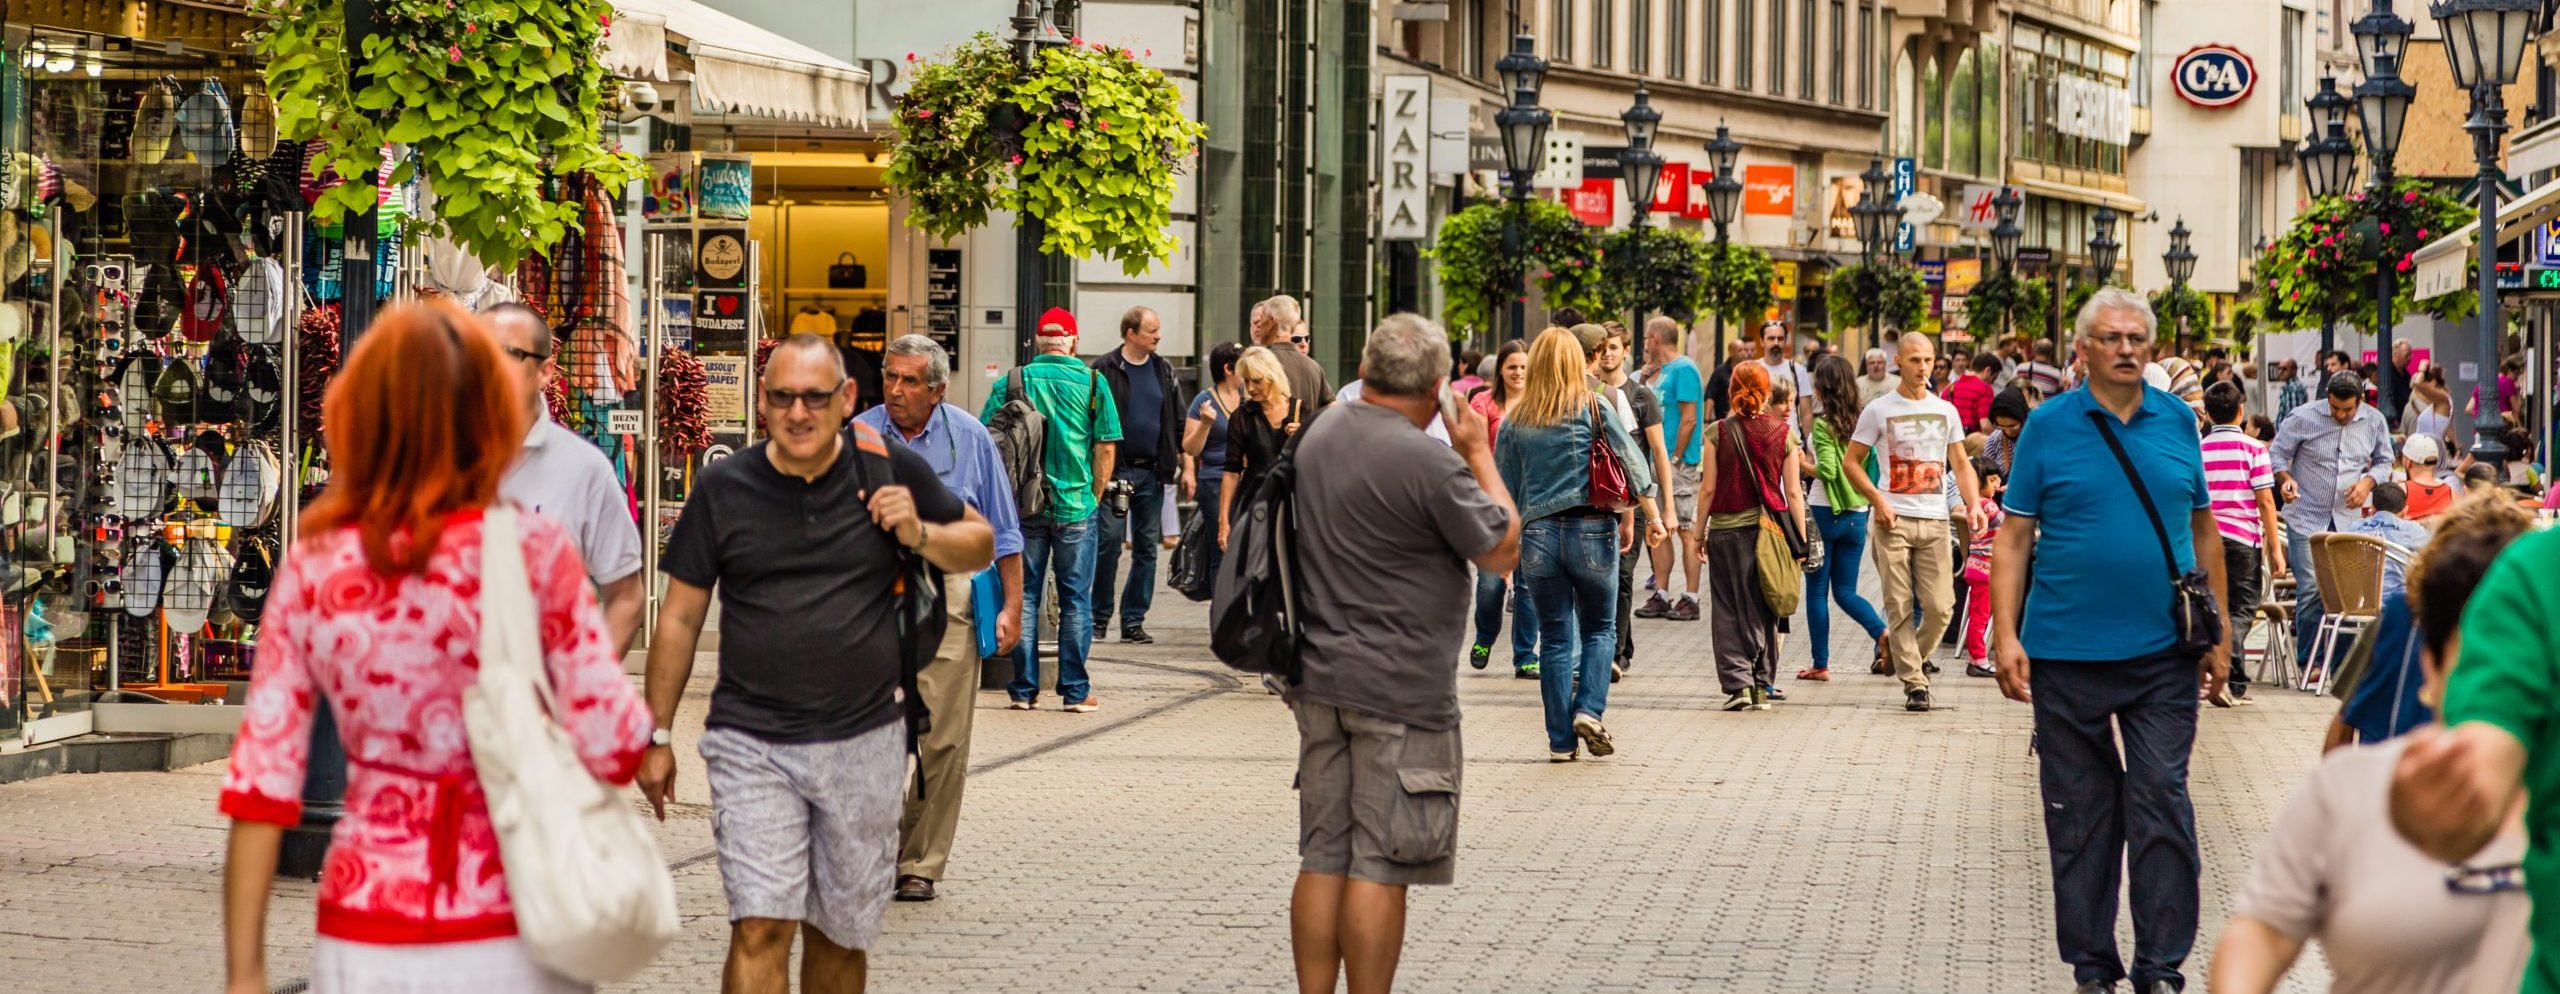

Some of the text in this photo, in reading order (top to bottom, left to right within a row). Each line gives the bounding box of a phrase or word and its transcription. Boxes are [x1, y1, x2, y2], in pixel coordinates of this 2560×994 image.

[2186, 59, 2243, 92] C&A
[1390, 89, 1419, 227] ZARA
[703, 295, 716, 315] I
[696, 318, 745, 330] BUDAPEST
[704, 362, 737, 372] ABSOLUT
[705, 375, 739, 385] UDAPEST
[1893, 419, 1946, 441] EX
[664, 466, 682, 480] 75
